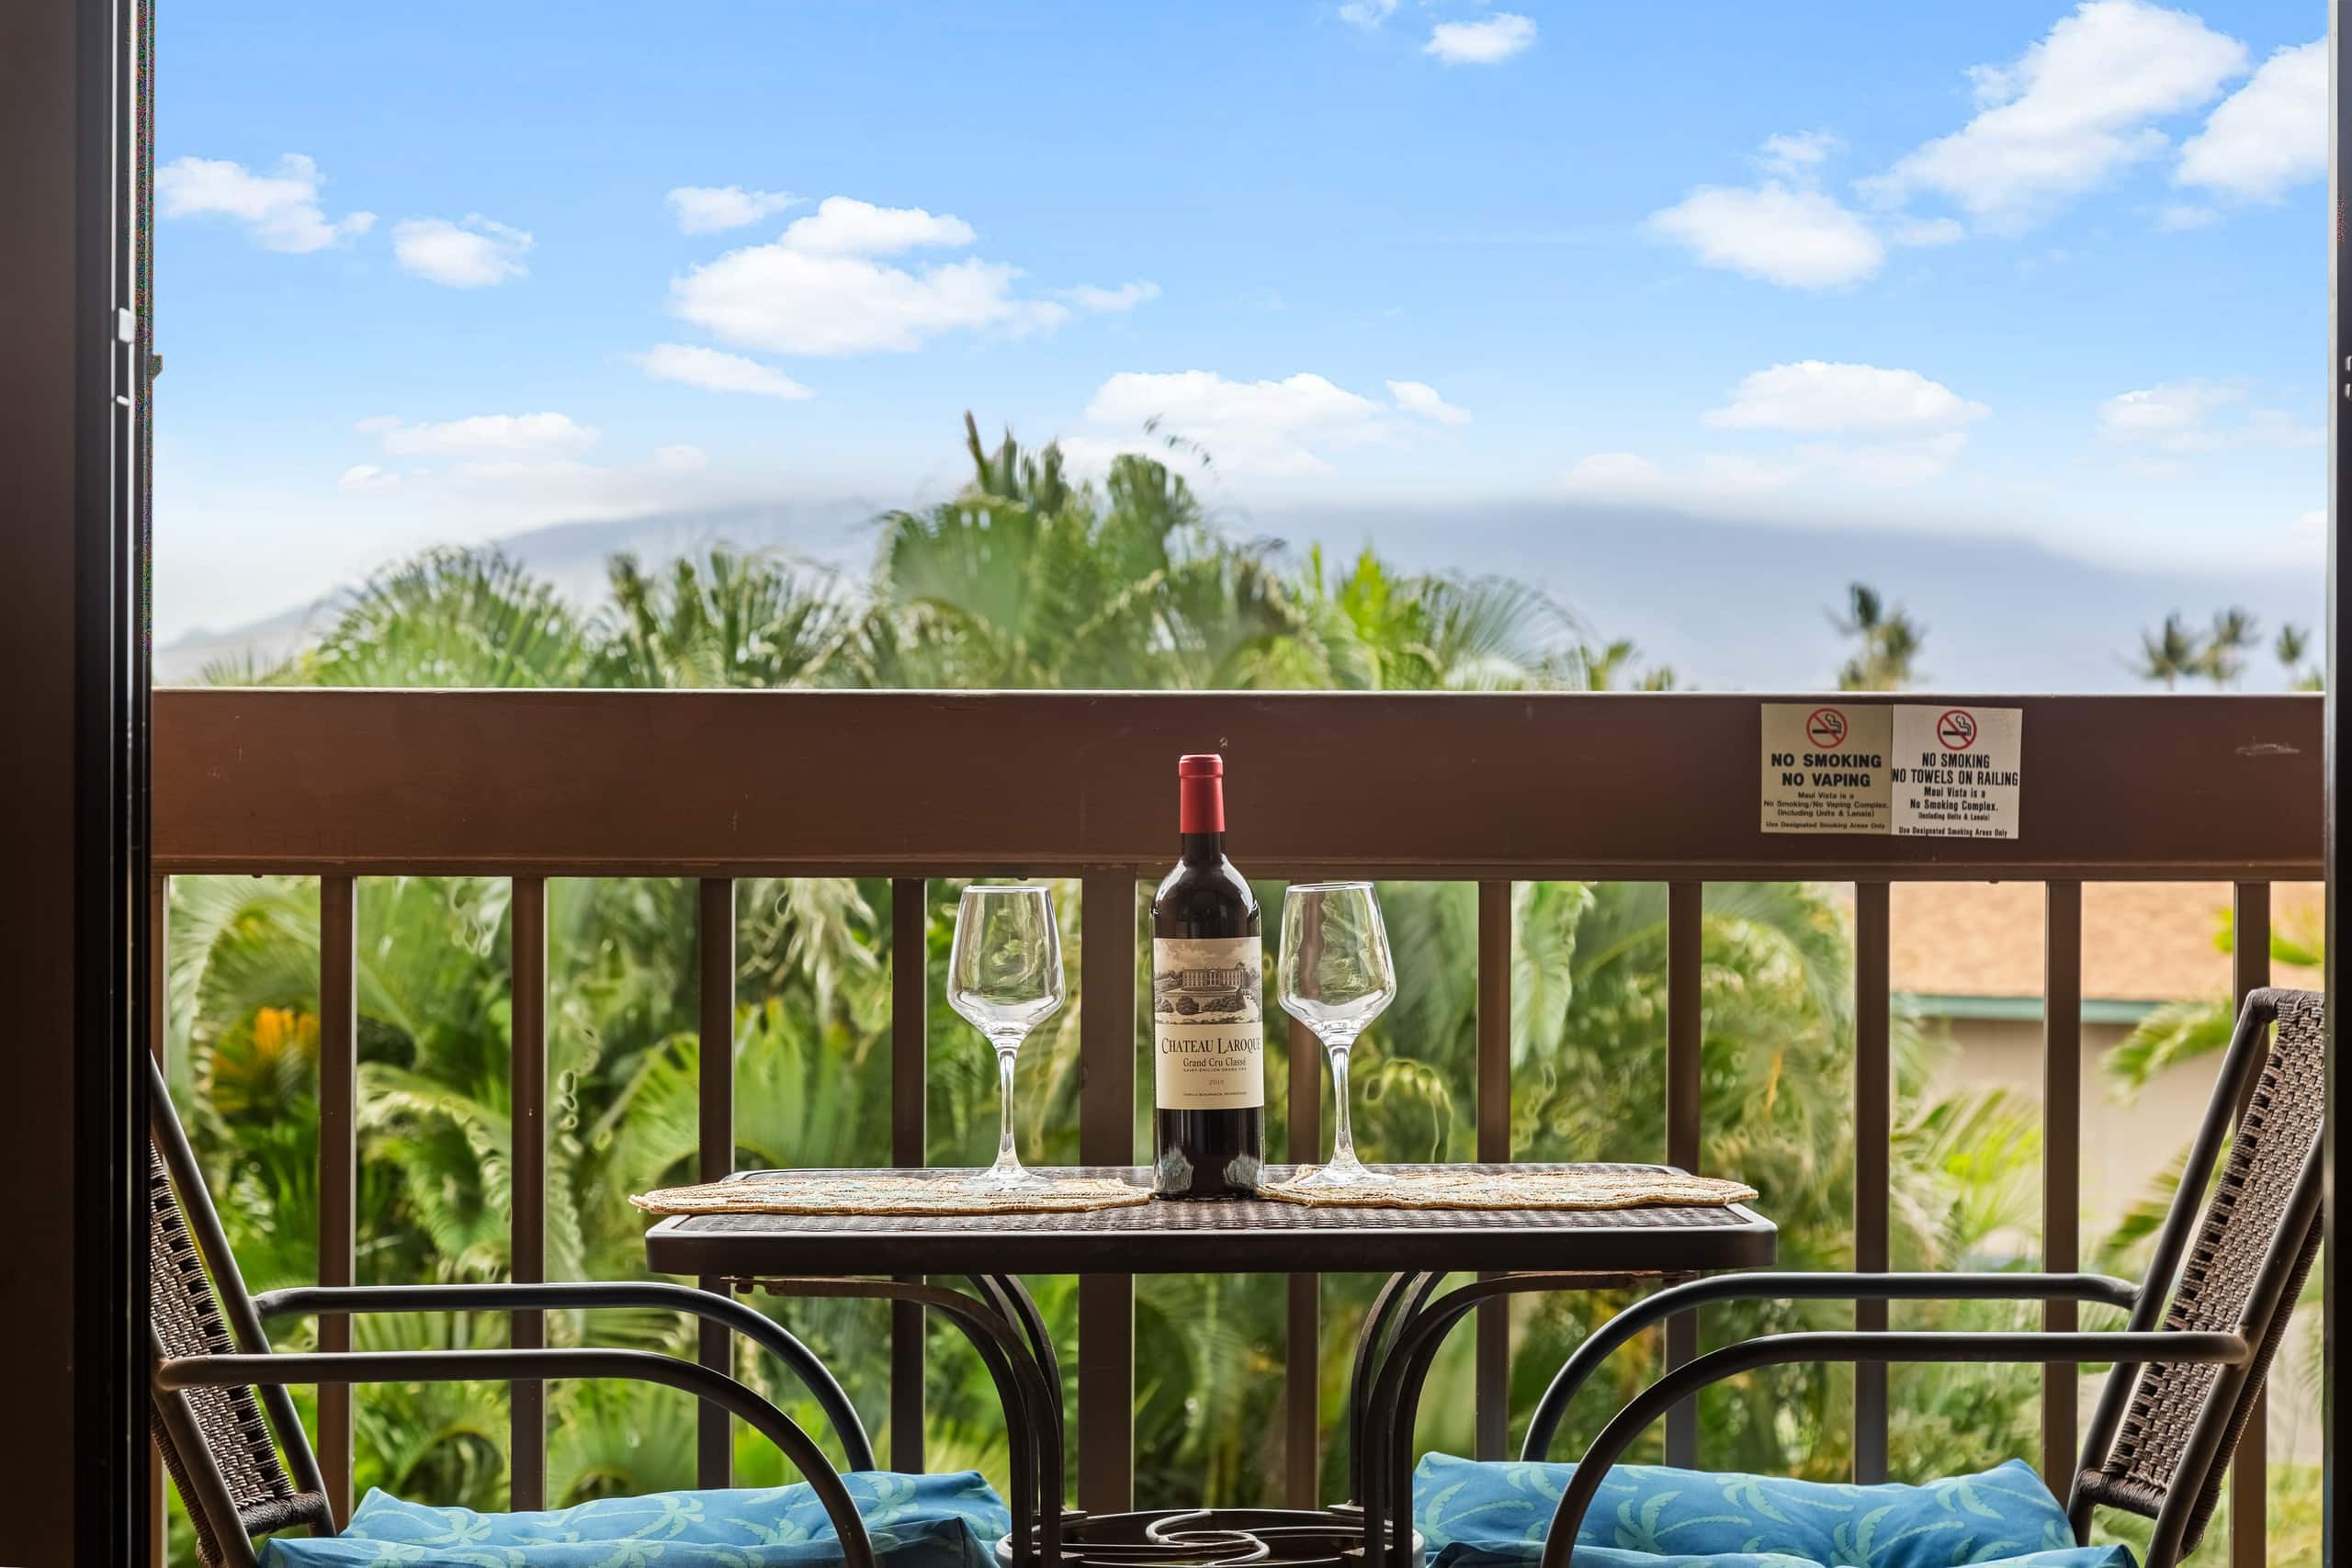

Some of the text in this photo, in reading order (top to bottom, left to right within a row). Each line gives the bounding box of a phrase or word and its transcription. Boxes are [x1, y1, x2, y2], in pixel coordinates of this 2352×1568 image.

[1771, 753, 1882, 768] NO SMOKING
[1922, 752, 1990, 769] NO SMOKING
[1782, 773, 1871, 787] NO VAPING
[1892, 768, 2018, 786] NO TOWELS ON RAILING
[1924, 786, 1985, 798] Maui Vista is a
[1777, 800, 1824, 808] Smoking/No
[1826, 801, 1851, 809] Vaping
[1910, 798, 1998, 812] No Smoking Complex.
[1778, 809, 1814, 818] (Including
[1899, 826, 2007, 838] Use Designated Smoking Areas Only
[1161, 1037, 1261, 1055] CHATEAU LAROQUE
[1183, 1057, 1206, 1067] Grand
[1209, 1057, 1223, 1067] Cru
